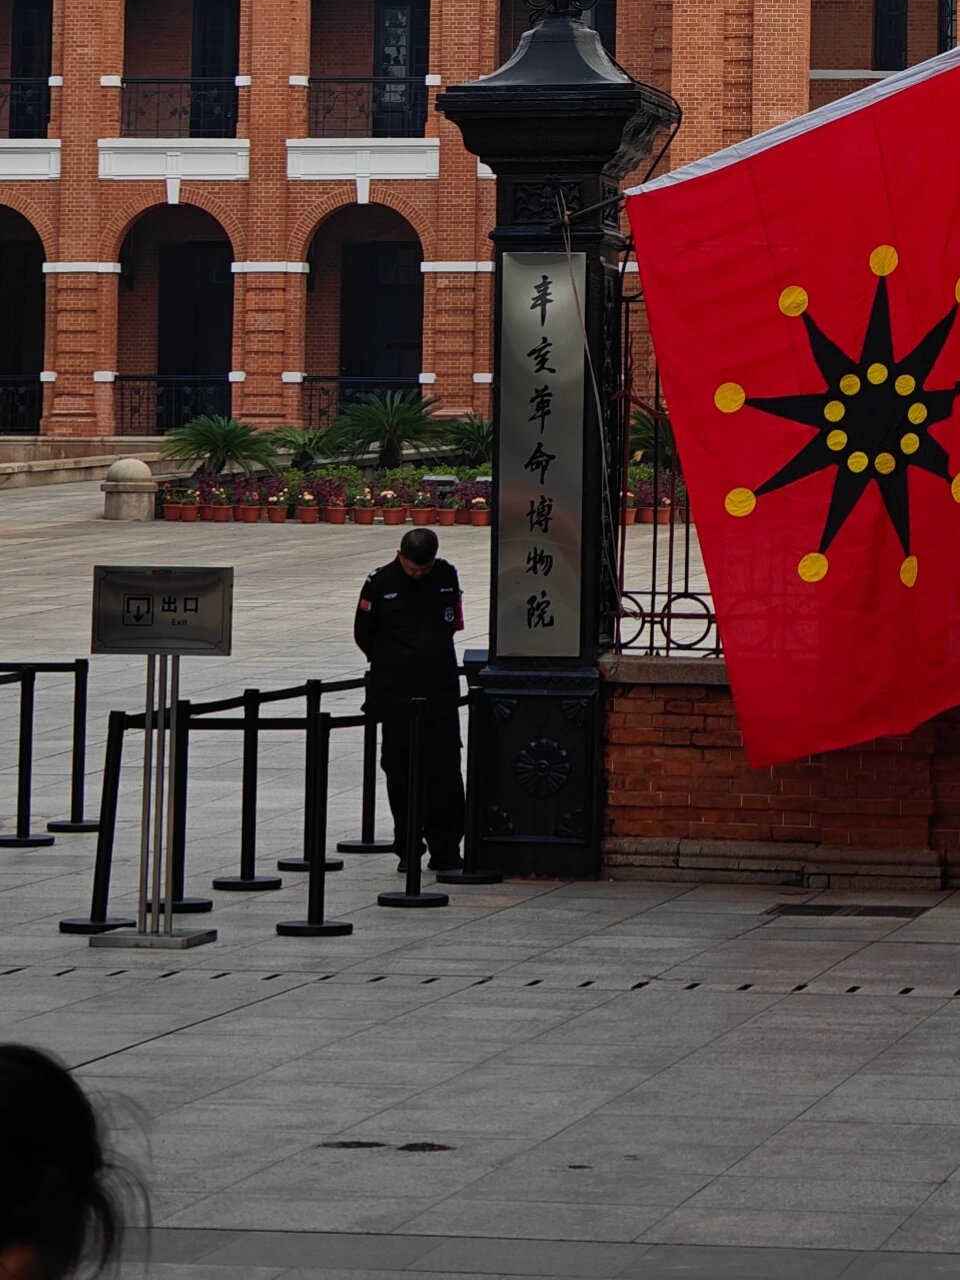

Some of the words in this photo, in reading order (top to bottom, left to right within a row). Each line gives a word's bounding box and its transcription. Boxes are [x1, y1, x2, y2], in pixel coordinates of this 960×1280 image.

[524, 275, 557, 629] 辛亥革命博物院
[161, 596, 198, 613] 出口
